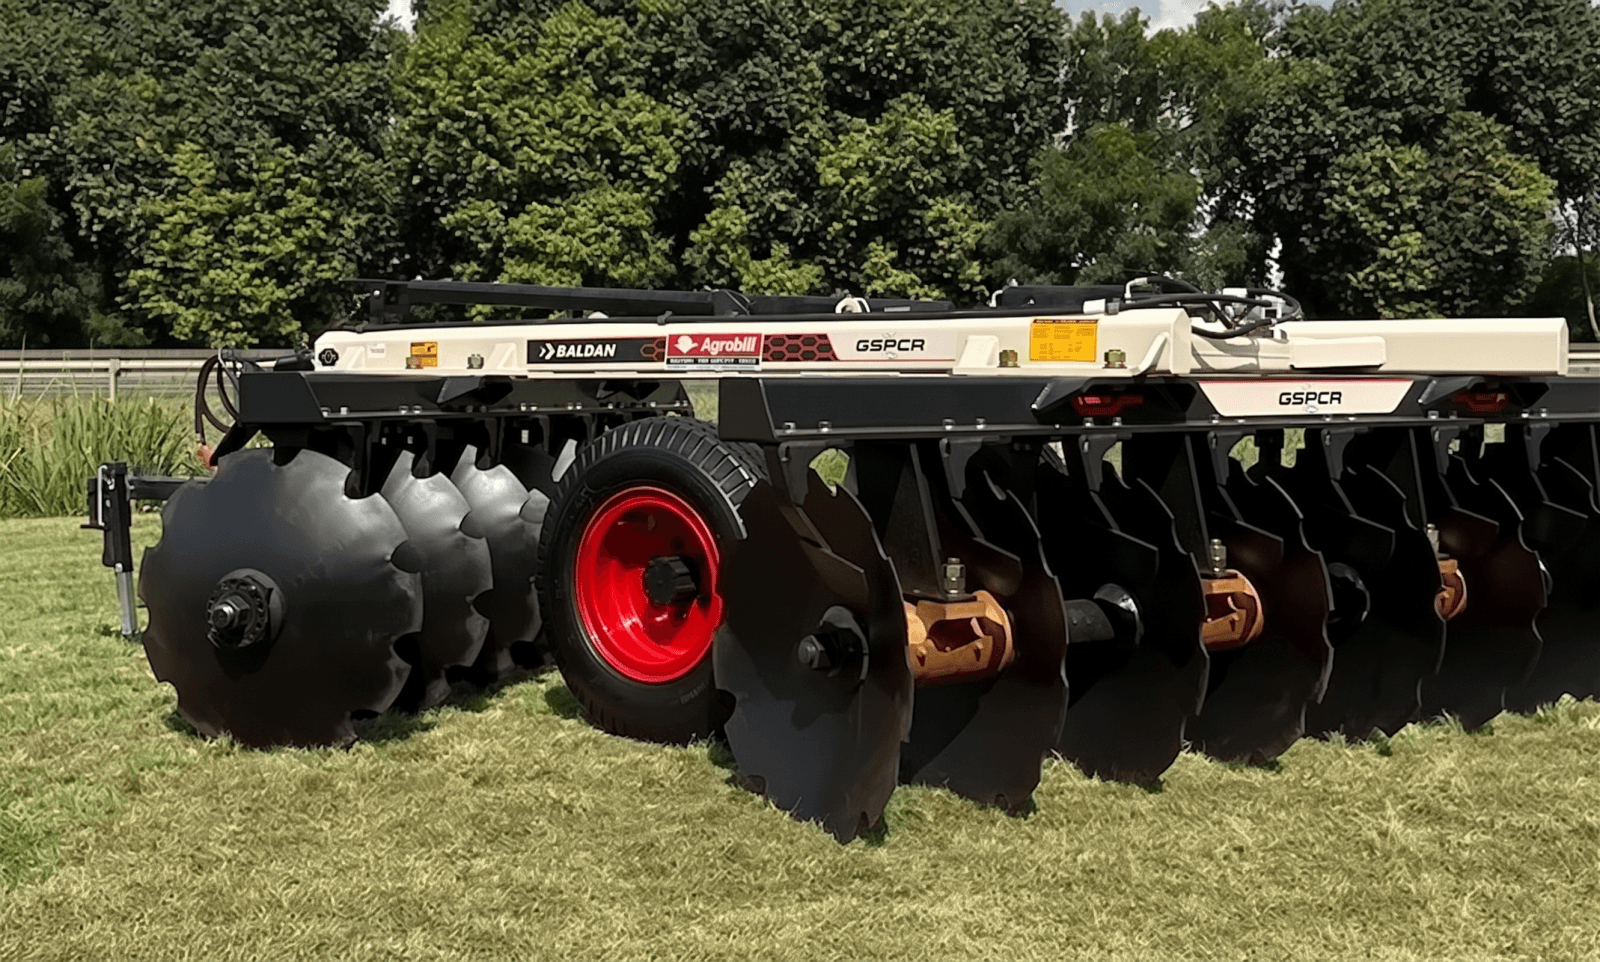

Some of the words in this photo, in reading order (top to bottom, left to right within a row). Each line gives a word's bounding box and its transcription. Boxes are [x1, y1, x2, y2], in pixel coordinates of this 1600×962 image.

[555, 344, 617, 358] BALDAN
[700, 336, 758, 356] Agrobill
[856, 339, 925, 352] GSPCR
[1278, 391, 1342, 405] GSPCR
